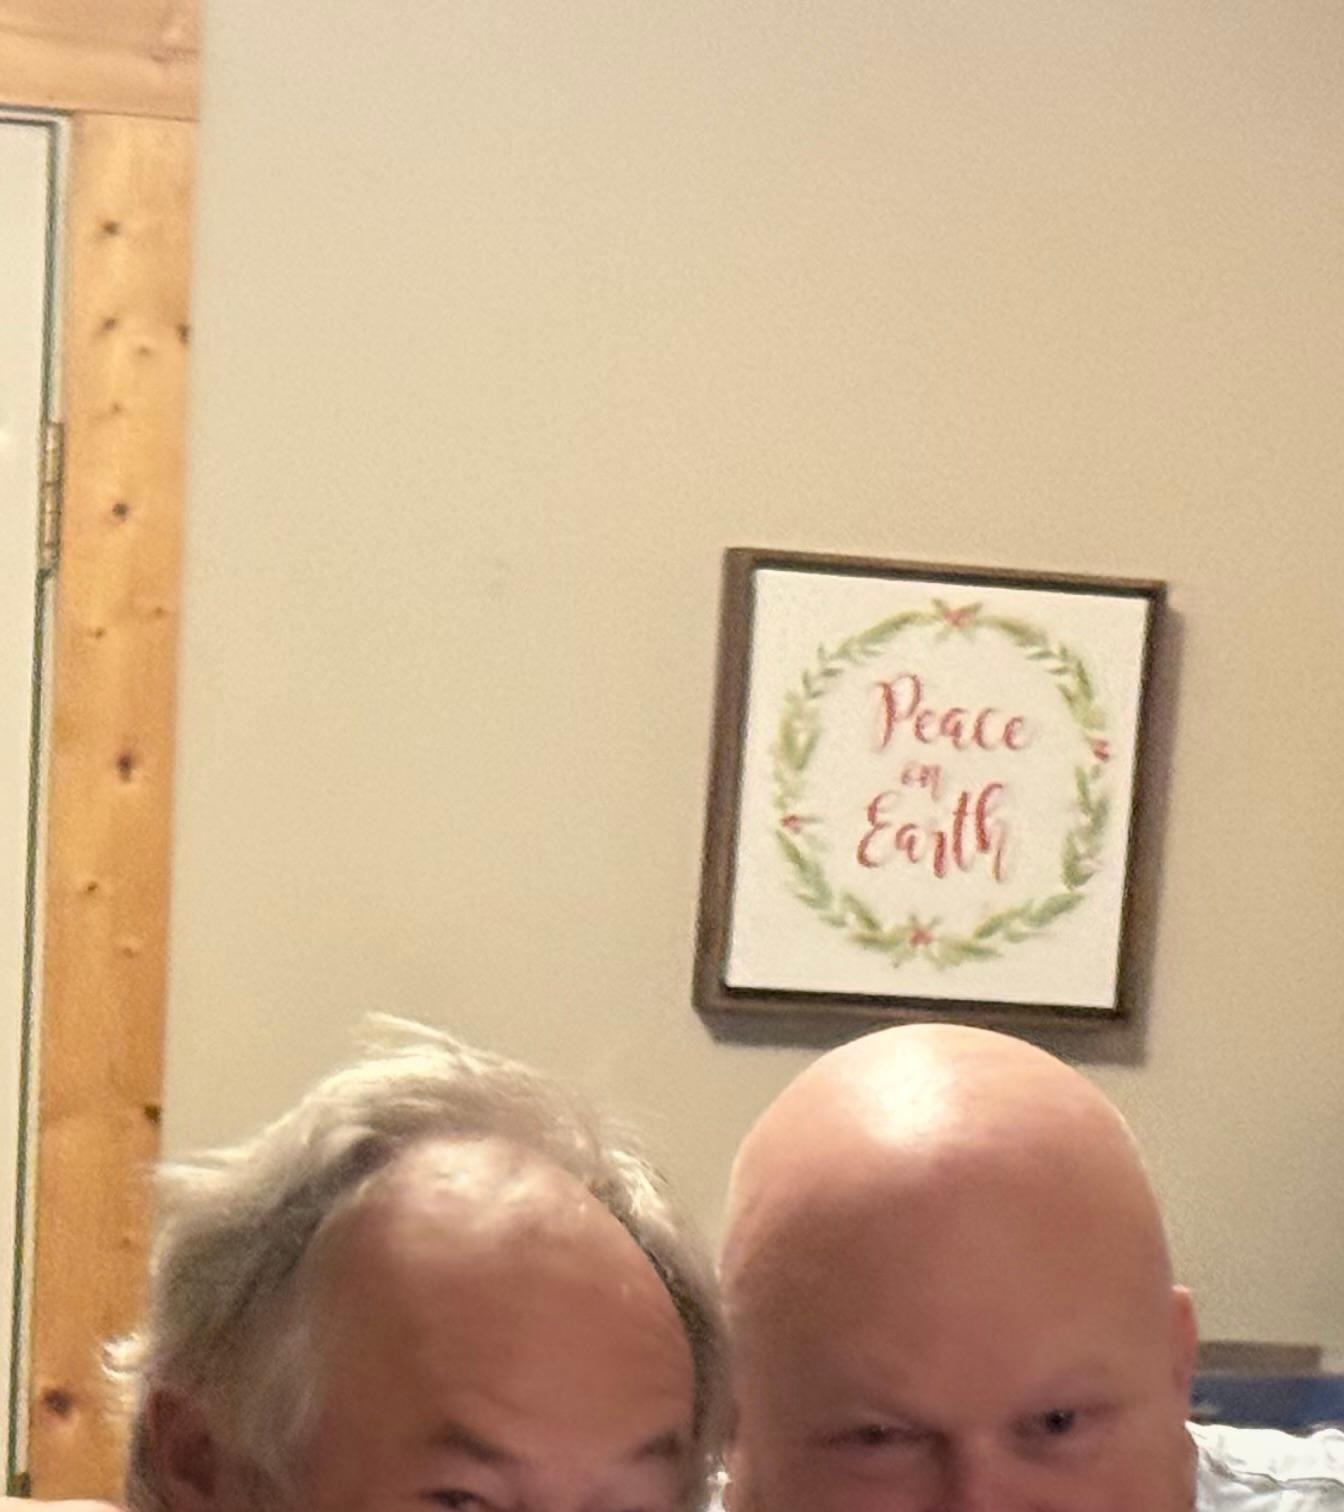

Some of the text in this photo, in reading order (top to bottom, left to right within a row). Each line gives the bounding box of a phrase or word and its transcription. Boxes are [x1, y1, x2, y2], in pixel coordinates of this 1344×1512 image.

[869, 673, 1032, 753] Peace
[900, 760, 944, 802] on
[855, 782, 1009, 885] Earth
